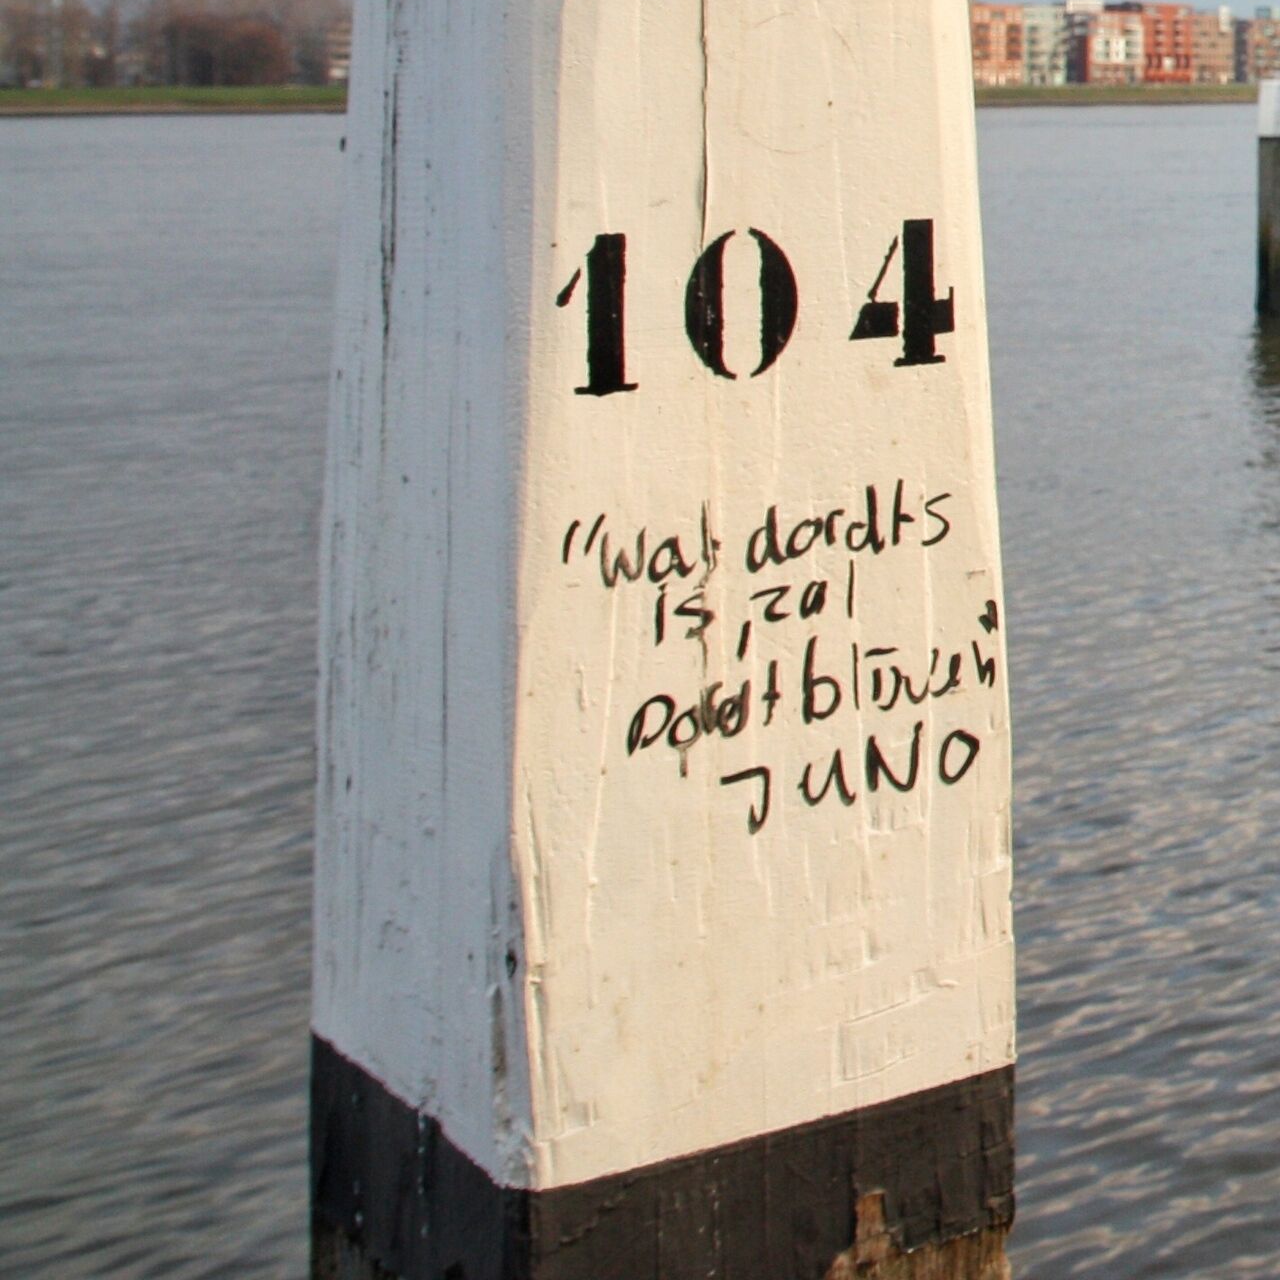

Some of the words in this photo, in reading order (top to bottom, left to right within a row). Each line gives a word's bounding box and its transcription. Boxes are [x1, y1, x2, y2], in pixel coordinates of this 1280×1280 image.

[556, 218, 955, 396] 104
[750, 558, 854, 622] zal
[720, 721, 980, 834] JUNO
